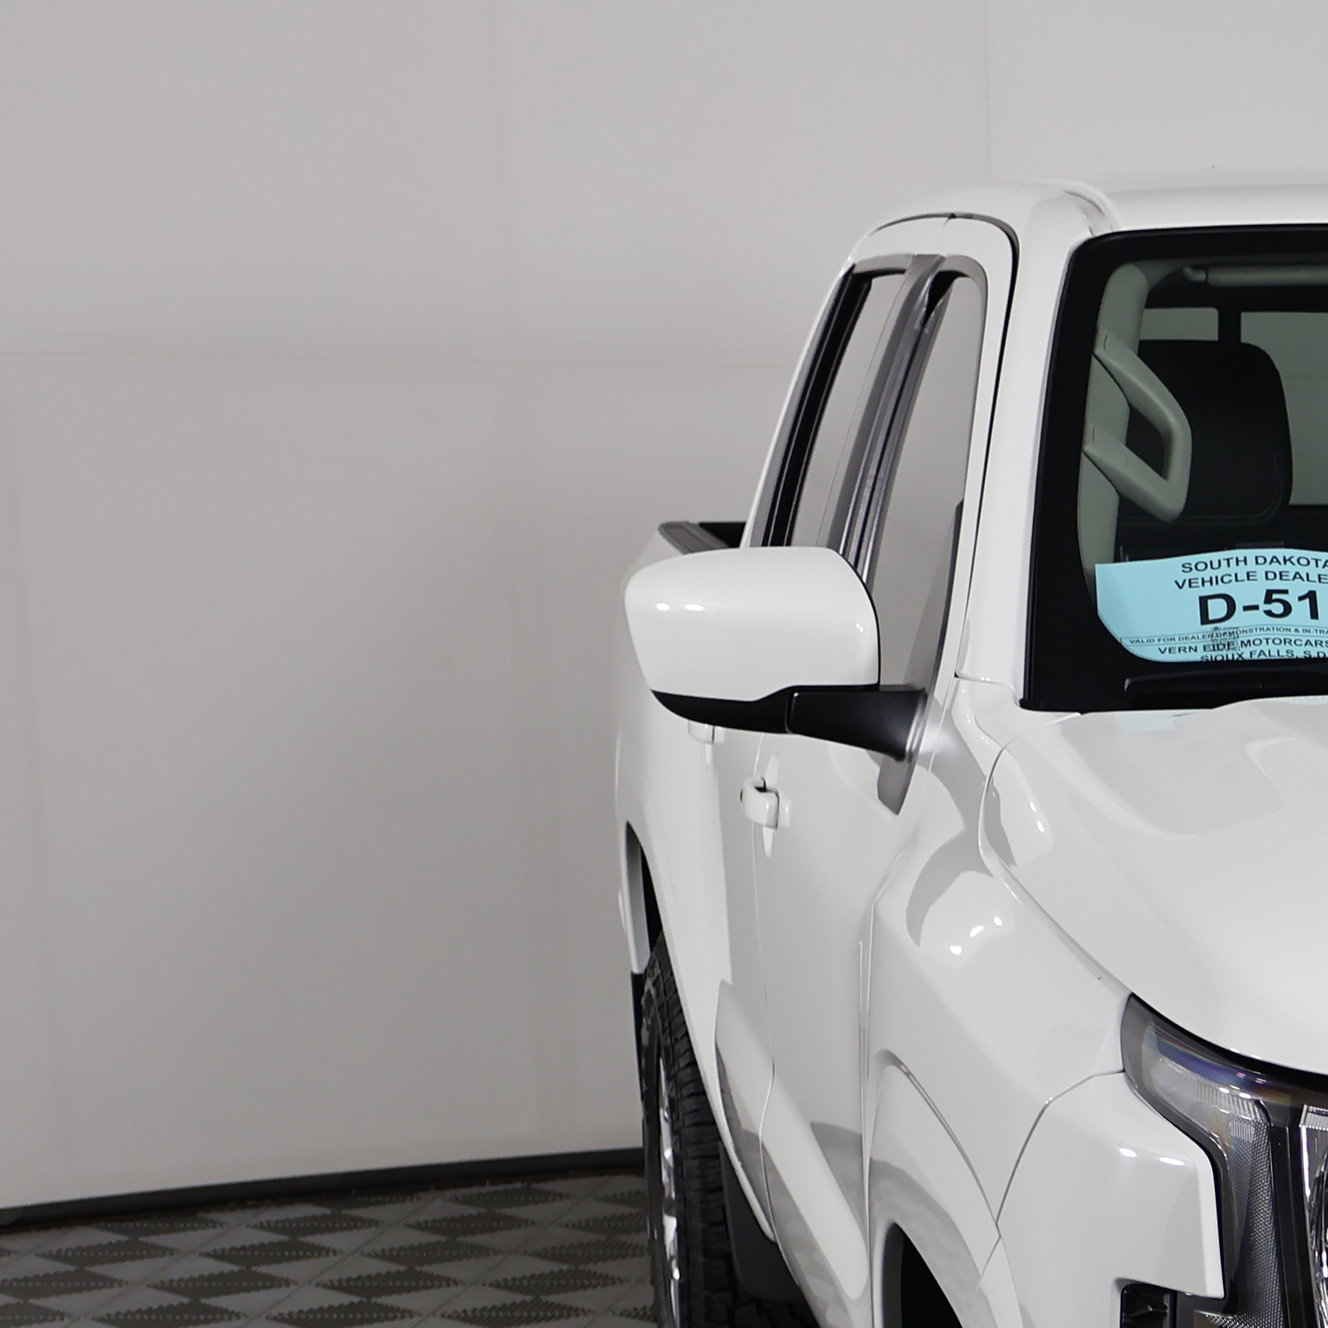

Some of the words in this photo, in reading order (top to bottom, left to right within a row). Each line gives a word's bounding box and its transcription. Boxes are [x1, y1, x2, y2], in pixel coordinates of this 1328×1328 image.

[1181, 557, 1248, 574] SOUTH
[1174, 571, 1258, 590] VEHICLE
[1197, 589, 1320, 626] D-51
[1158, 646, 1198, 654] VERN
[1203, 641, 1237, 652] EIDE
[1201, 652, 1245, 661] SIOUX
